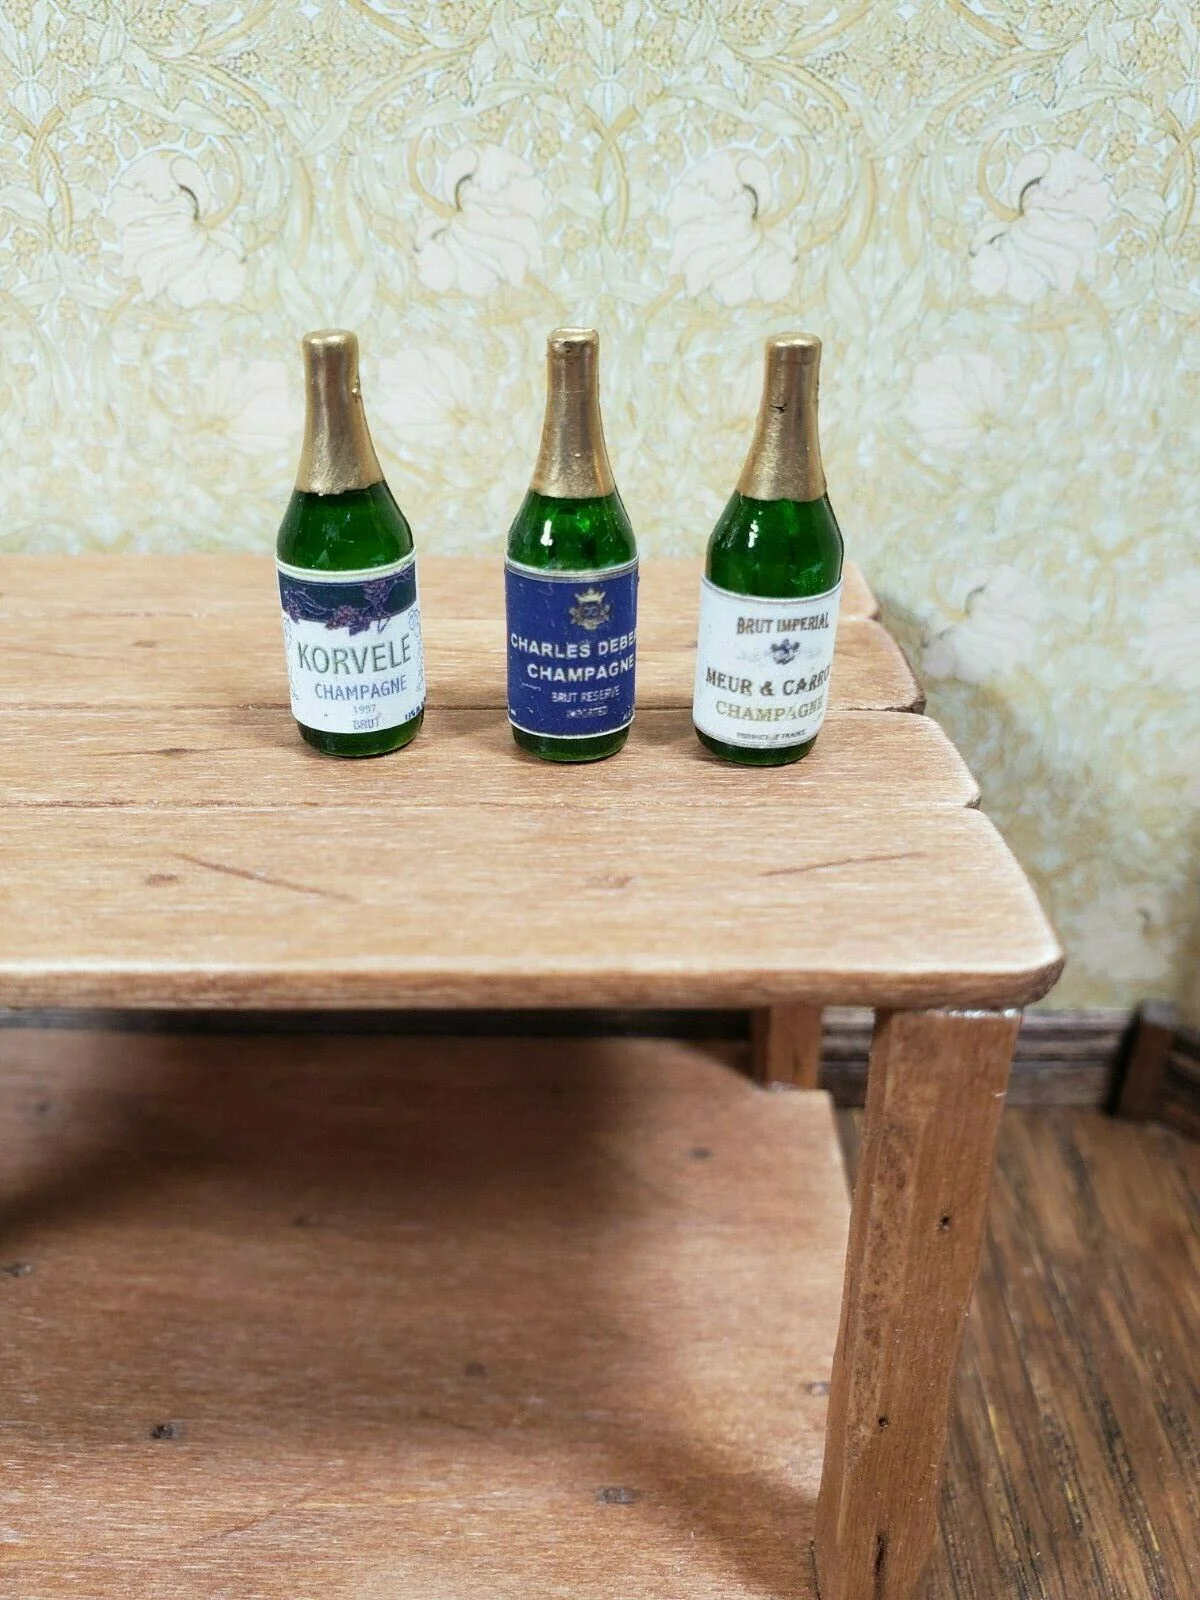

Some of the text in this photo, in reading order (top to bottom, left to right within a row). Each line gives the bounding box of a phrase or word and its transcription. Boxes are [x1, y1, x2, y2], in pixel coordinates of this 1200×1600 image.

[736, 611, 830, 636] BRUT IMPERIAL
[297, 634, 412, 675] KORVELE
[510, 632, 591, 659] CHARLES
[527, 654, 636, 683] CHAMPAGNE
[706, 666, 753, 697] MEUR
[759, 681, 776, 697] &
[314, 675, 408, 702] CHAMPAGNE
[551, 684, 621, 703] BRUT RESERVE
[716, 694, 824, 722] CHAMPAGNE
[352, 717, 380, 731] BRUT
